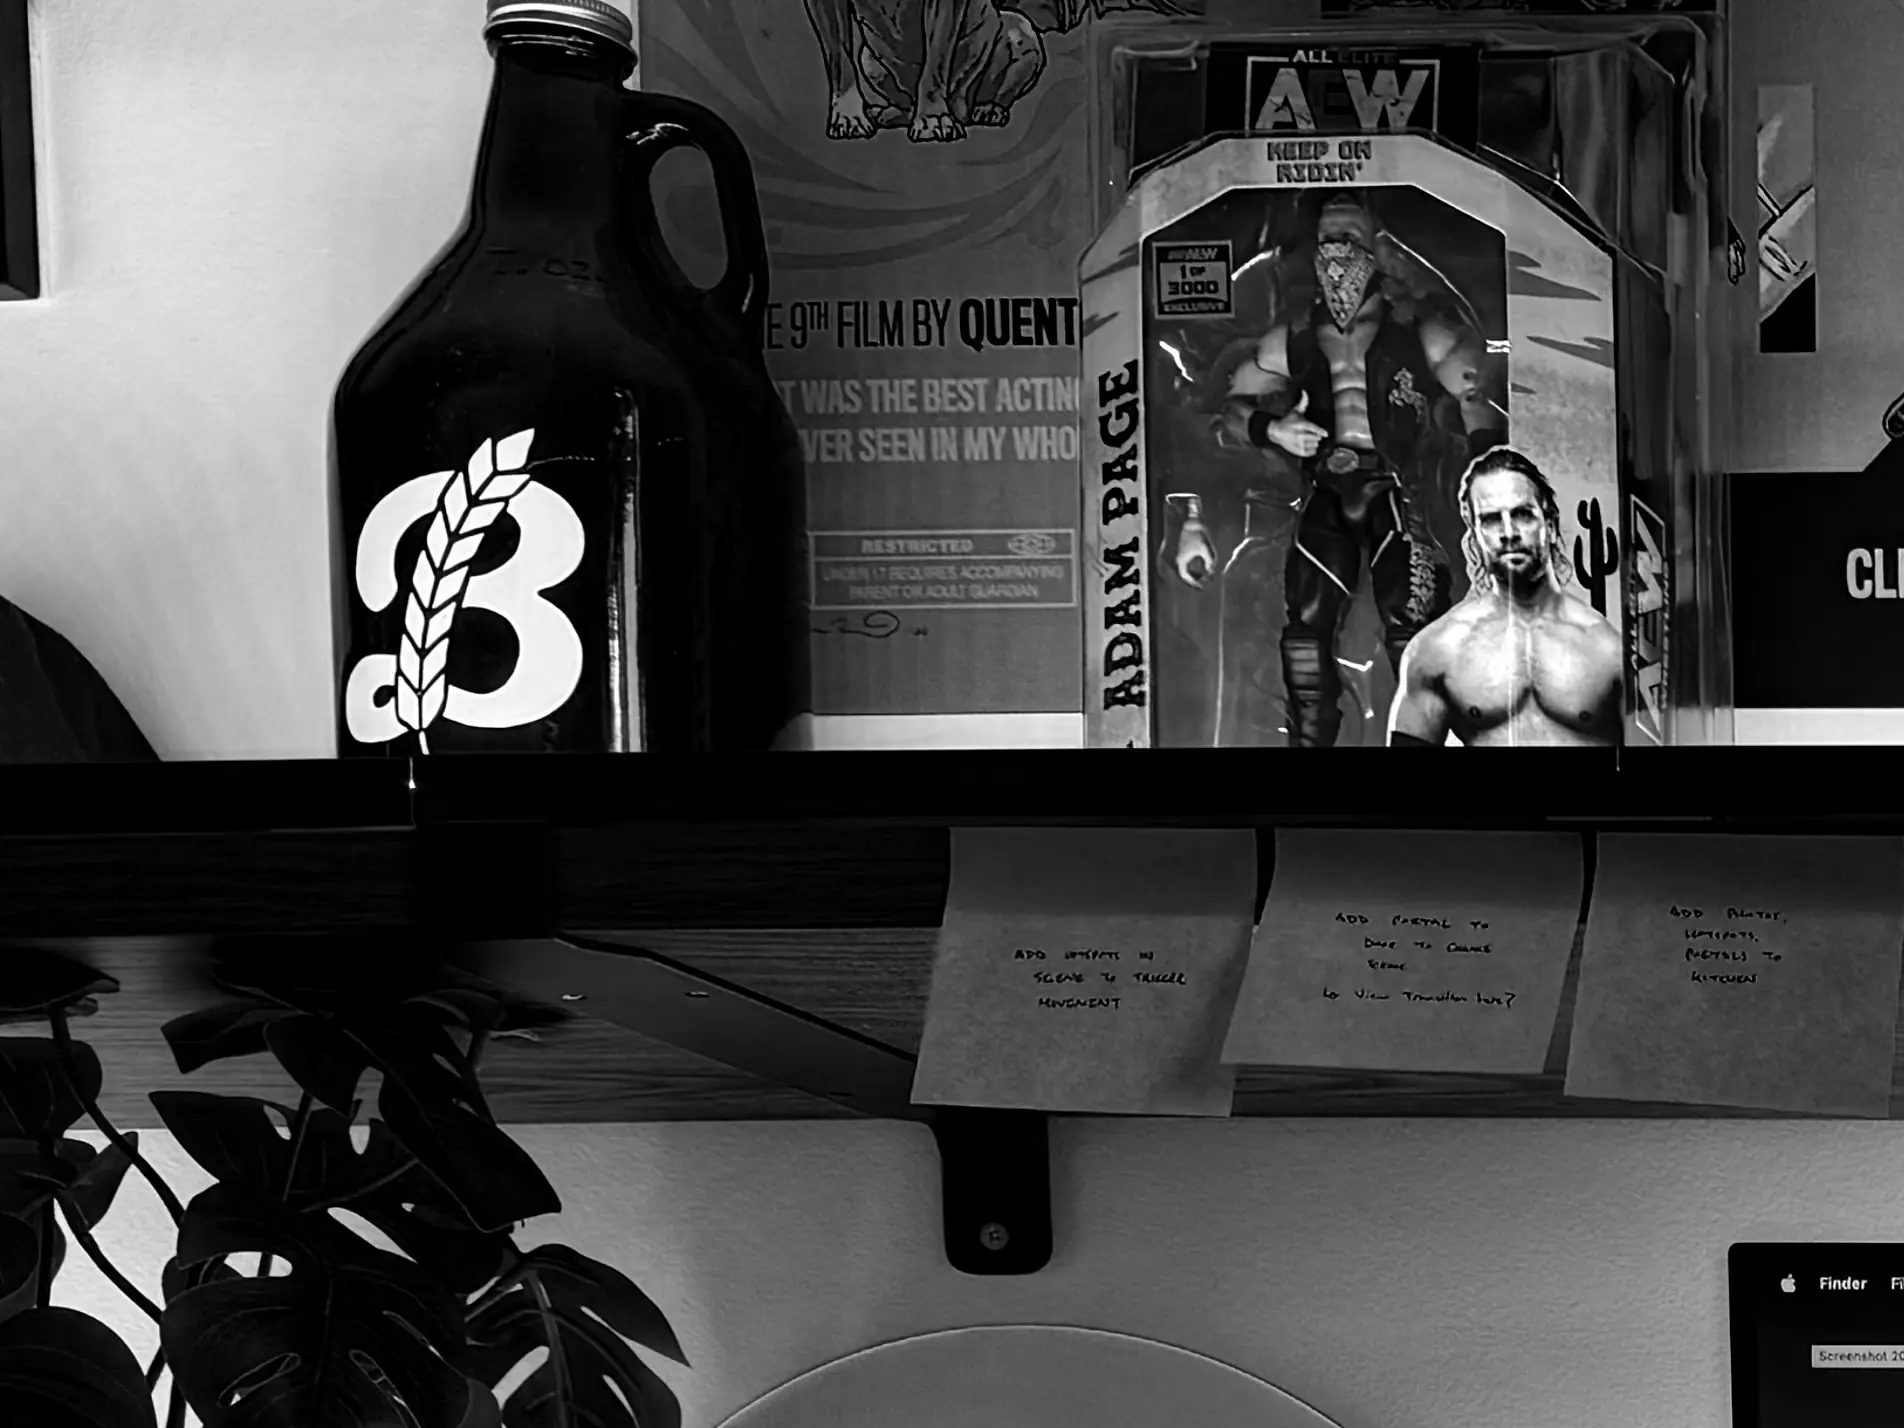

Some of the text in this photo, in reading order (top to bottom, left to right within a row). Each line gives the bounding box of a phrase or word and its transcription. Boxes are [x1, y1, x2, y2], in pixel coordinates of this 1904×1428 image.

[1255, 67, 1430, 131] AEW
[1267, 140, 1372, 161] KEEP ON
[1277, 162, 1363, 183] RIDIN'
[1167, 280, 1219, 296] 3000
[790, 301, 829, 349] 9TH
[837, 299, 904, 348] FILM
[912, 298, 951, 347] BY
[800, 379, 864, 415] WAS
[864, 378, 919, 414] THE
[922, 377, 988, 413] BEST
[859, 425, 1077, 463] SEEN IN MY WHO
[1099, 357, 1147, 711] ADAM PAGE
[860, 538, 974, 554] RESTRICTED
[1335, 912, 1370, 925] ADD
[1669, 905, 1705, 919] ADD
[1014, 948, 1047, 961] ADD
[1819, 1276, 1868, 1291] Finder
[1818, 1350, 1889, 1363] Screenshot
